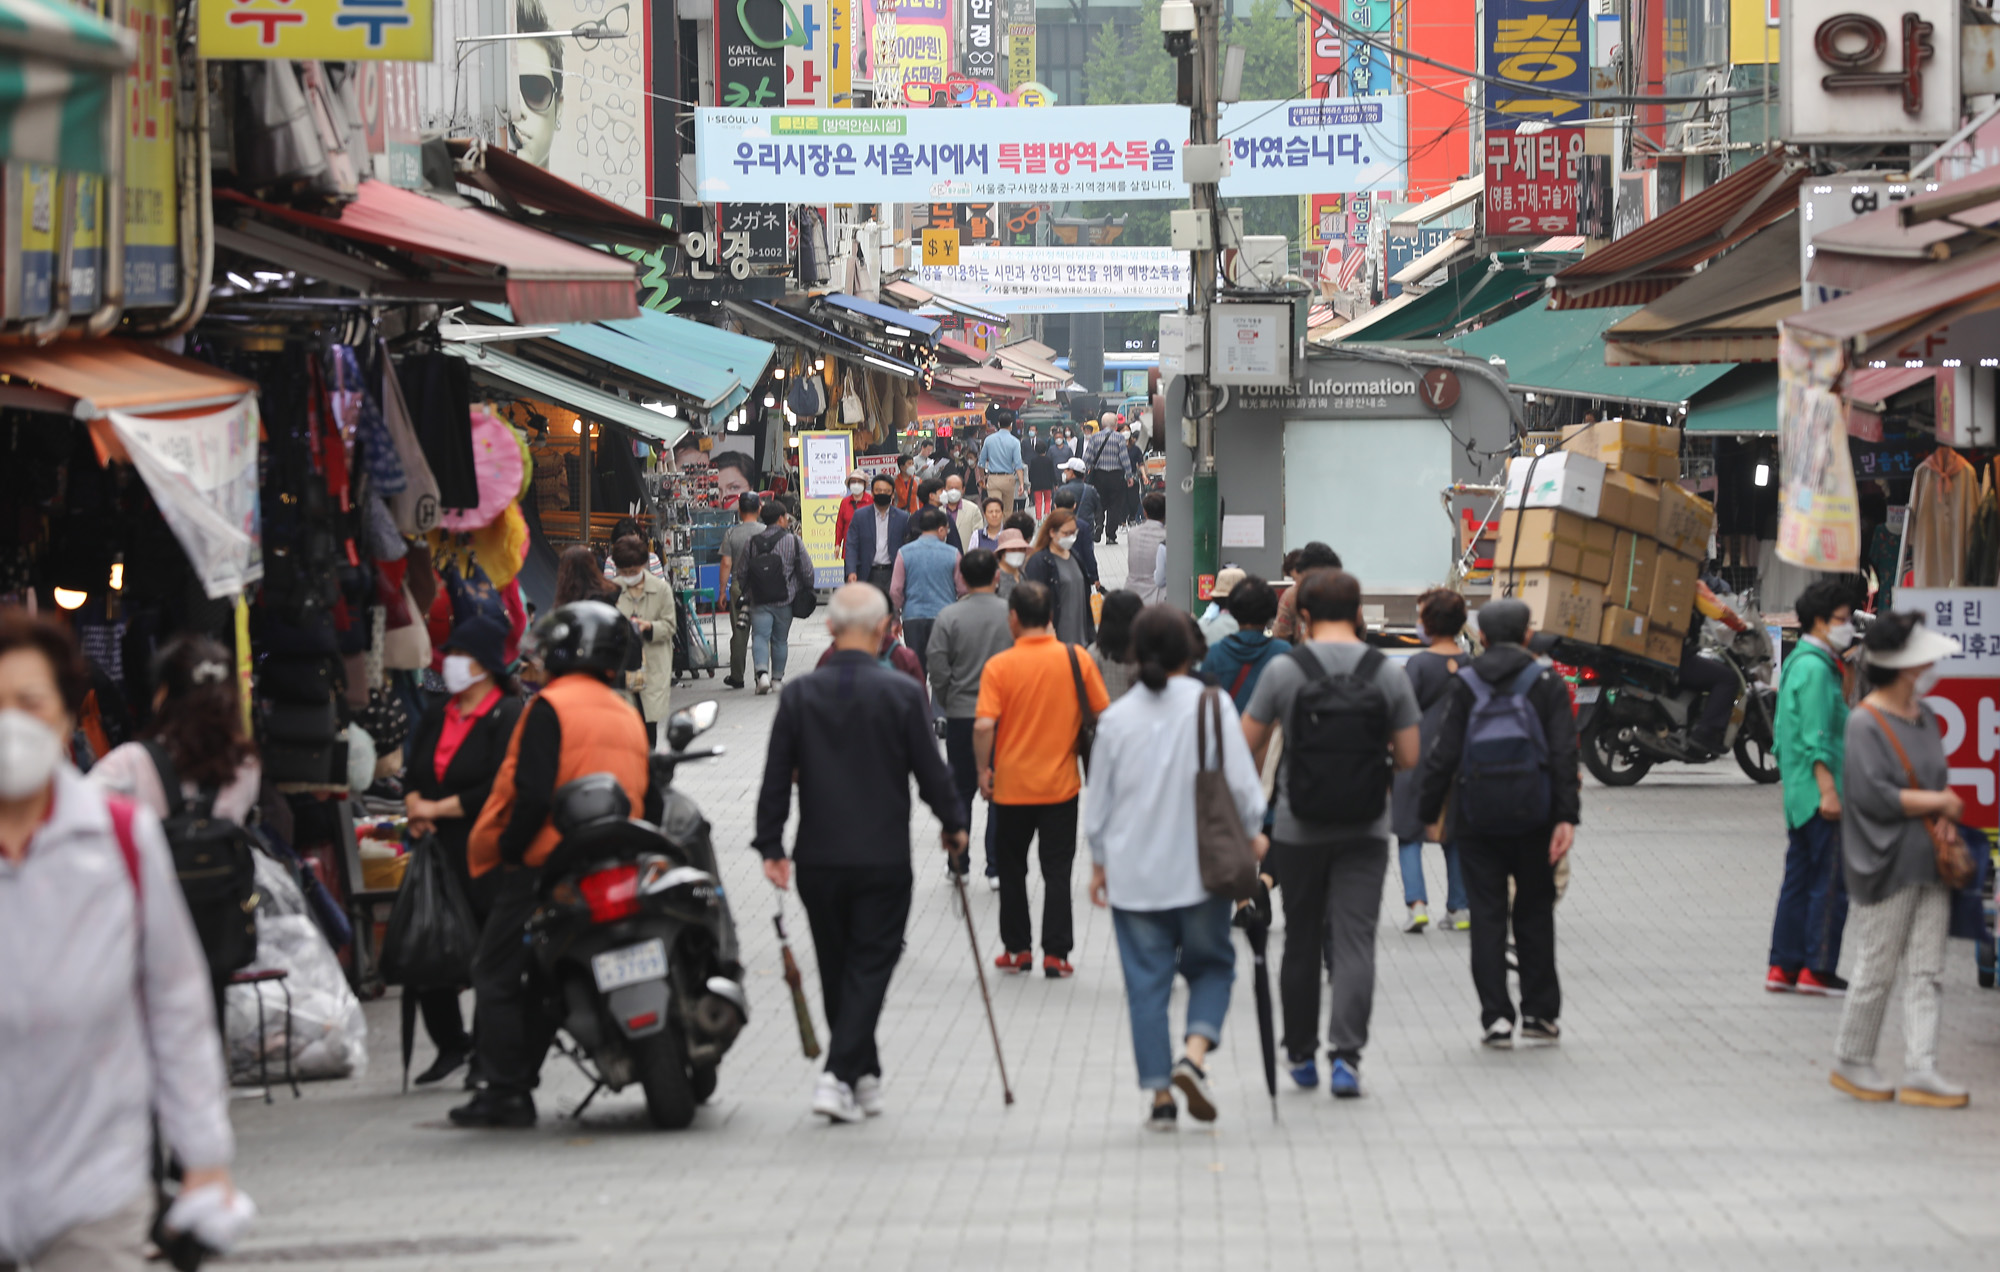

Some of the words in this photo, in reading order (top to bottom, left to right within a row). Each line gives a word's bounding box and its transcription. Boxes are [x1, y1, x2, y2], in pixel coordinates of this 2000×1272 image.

[970, 0, 993, 47] 안경
[728, 45, 758, 55] KARL
[728, 57, 777, 67] OPTICAL
[1814, 12, 1934, 116] 약
[1340, 113, 1358, 123] 1339
[733, 142, 857, 177] 우리시장은
[864, 143, 989, 176] 서울시에서
[997, 139, 1176, 175] 특별방역소독을
[1130, 179, 1176, 192] 살립니다.
[729, 211, 780, 231] メガネ
[685, 231, 750, 280] 안경
[928, 238, 938, 257] $
[943, 239, 954, 257] ¥
[947, 264, 990, 282] 이용하는
[994, 264, 1026, 282] 시민과
[1030, 264, 1061, 282] 상인의
[1066, 264, 1098, 282] 안전을
[1103, 264, 1124, 282] 위해
[1128, 264, 1182, 282] 예방소독을
[1238, 383, 1302, 396] Tourist
[1308, 378, 1416, 396] Information
[1333, 397, 1388, 409] 관광안내소
[1934, 599, 1952, 627] 열
[1964, 599, 1981, 627] 린
[1941, 633, 2000, 660] 인후과
